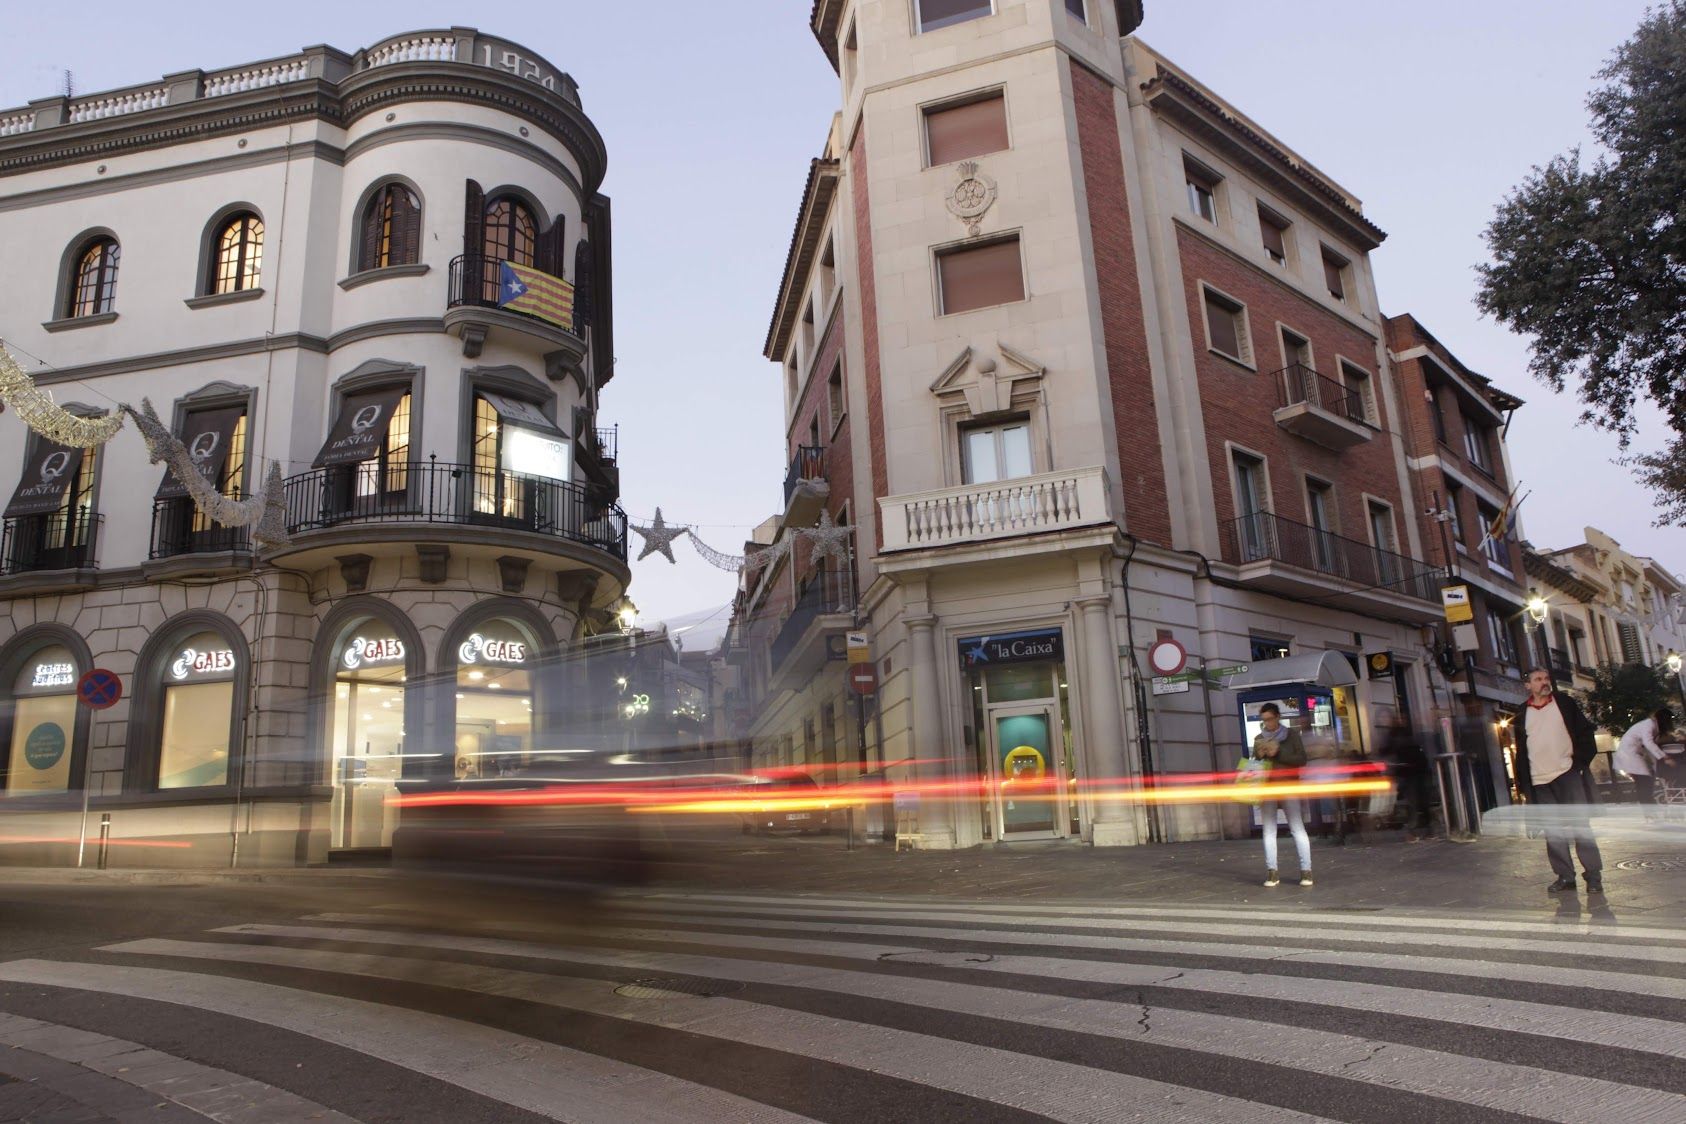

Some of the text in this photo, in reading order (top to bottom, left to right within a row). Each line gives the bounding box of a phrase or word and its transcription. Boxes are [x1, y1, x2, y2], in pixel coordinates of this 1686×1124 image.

[332, 434, 374, 449] DENTAL
[21, 486, 61, 497] DENTAL
[363, 639, 403, 660] GAES
[486, 641, 526, 661] GAES
[193, 650, 235, 671] GAES
